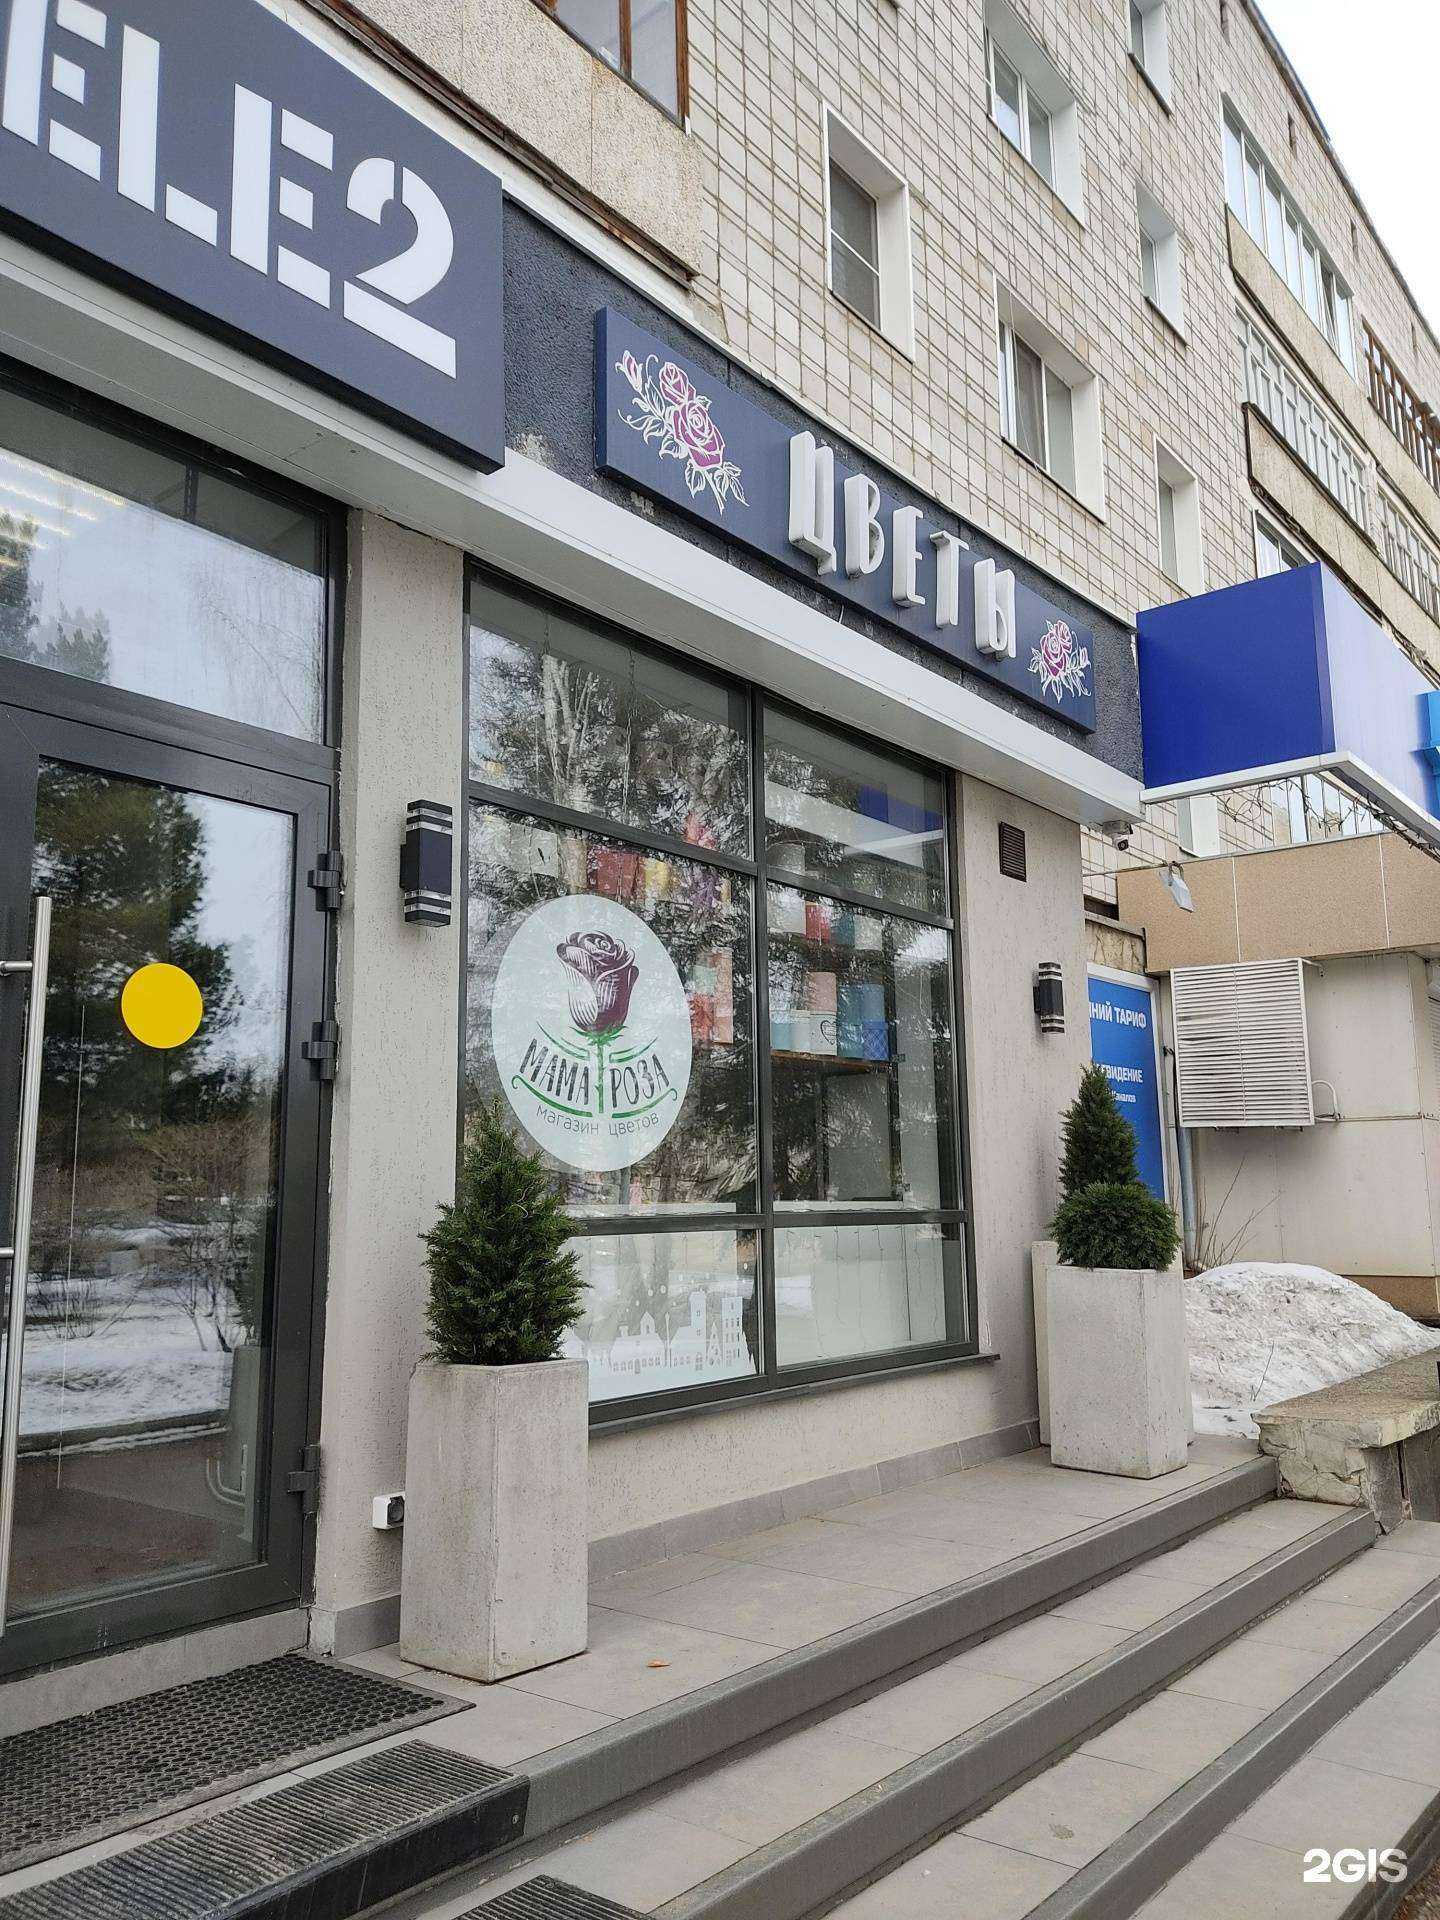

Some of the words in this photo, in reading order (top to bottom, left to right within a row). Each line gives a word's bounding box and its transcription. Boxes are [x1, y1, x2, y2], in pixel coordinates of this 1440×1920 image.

[789, 430, 1017, 659] ЦВЕТЫ
[1113, 1006, 1147, 1029] ТАРИФ
[519, 1038, 590, 1106] МАМА
[608, 1053, 670, 1108] РОЗА
[536, 1104, 600, 1136] магазин
[607, 1111, 660, 1138] цветов
